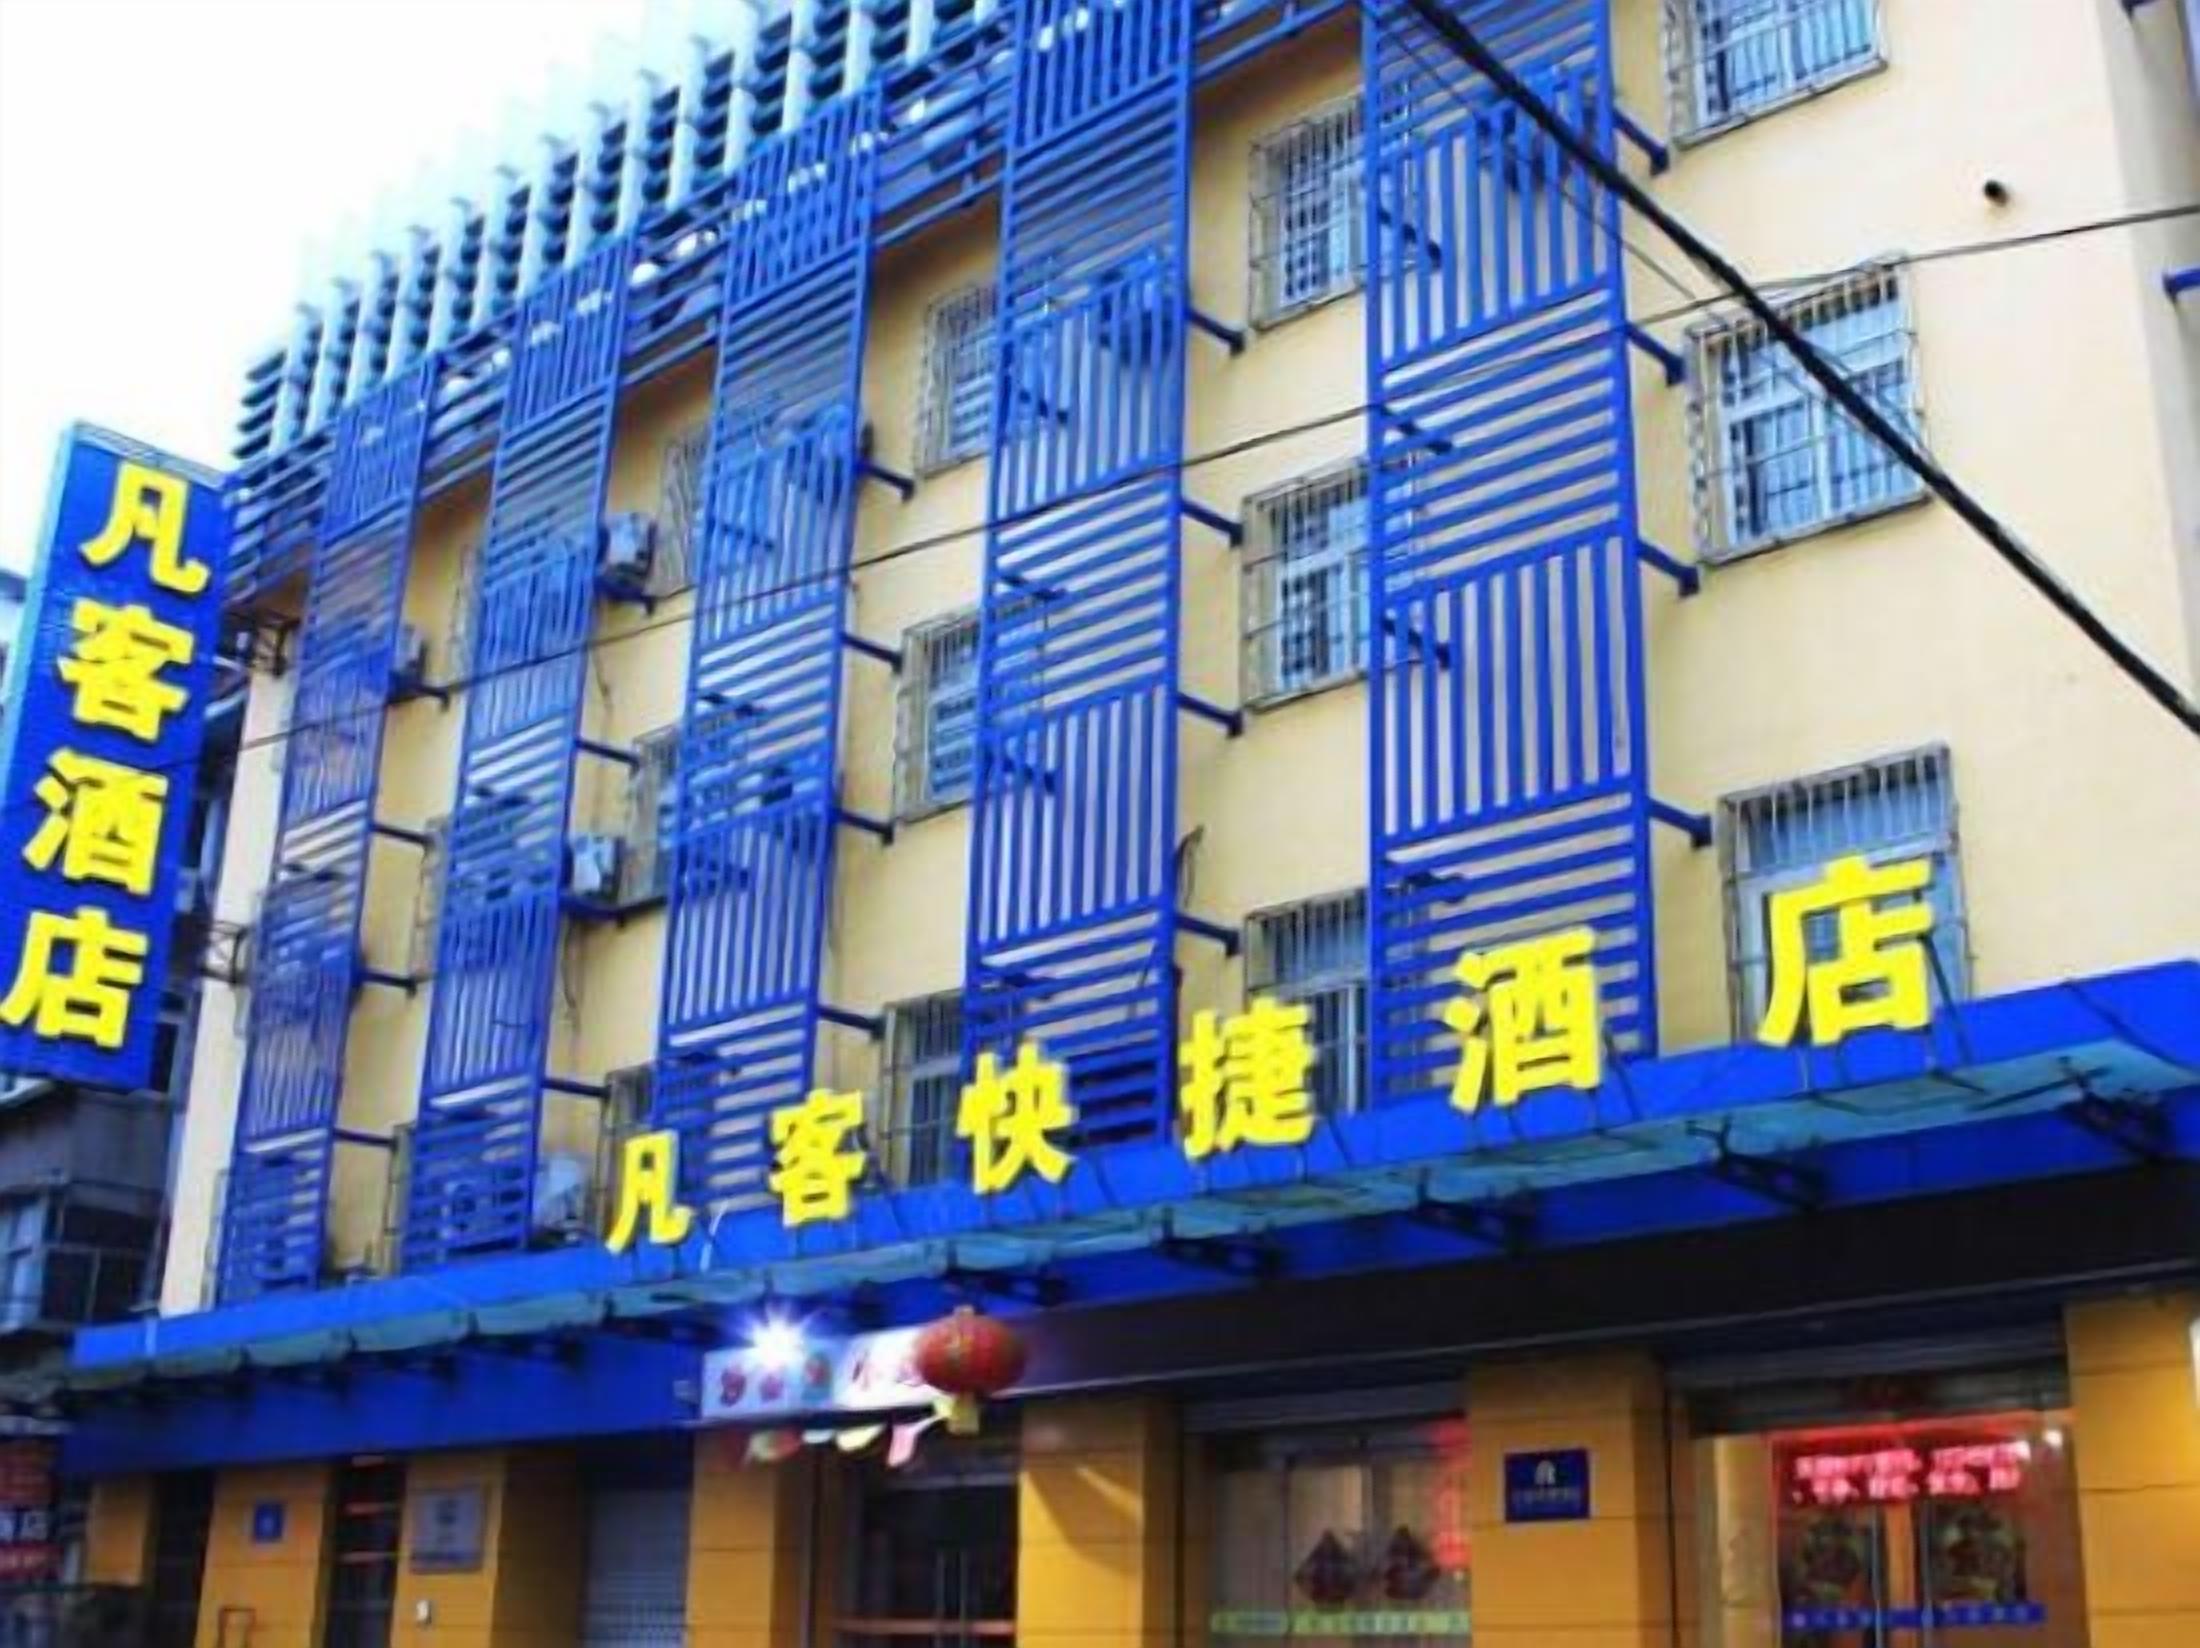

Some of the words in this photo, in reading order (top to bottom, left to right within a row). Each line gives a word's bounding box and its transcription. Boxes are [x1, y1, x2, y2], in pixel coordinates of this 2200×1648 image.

[0, 462, 209, 1048] 凡客酒店
[605, 856, 1933, 1254] 凡客快捷酒店
